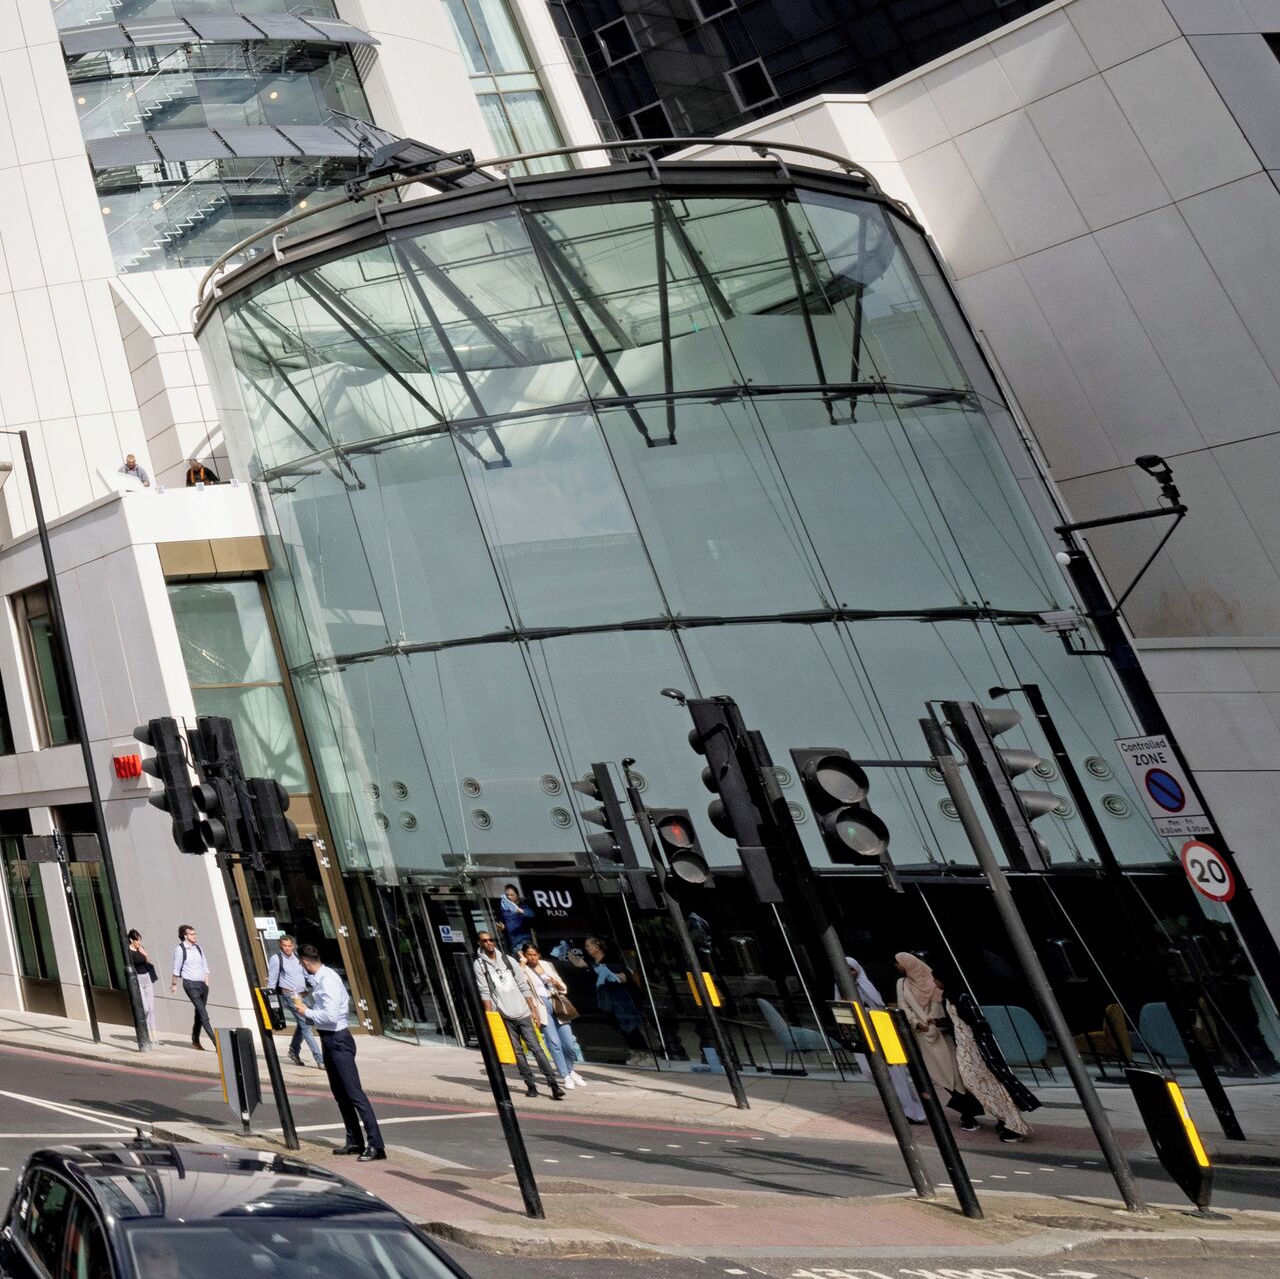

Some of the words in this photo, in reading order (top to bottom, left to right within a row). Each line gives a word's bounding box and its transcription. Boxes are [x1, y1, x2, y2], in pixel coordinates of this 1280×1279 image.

[1121, 739, 1168, 752] Controlled
[1132, 752, 1167, 766] ZONE
[1190, 858, 1226, 884] 20
[533, 890, 573, 908] RIU
[547, 909, 568, 917] PLAZA
